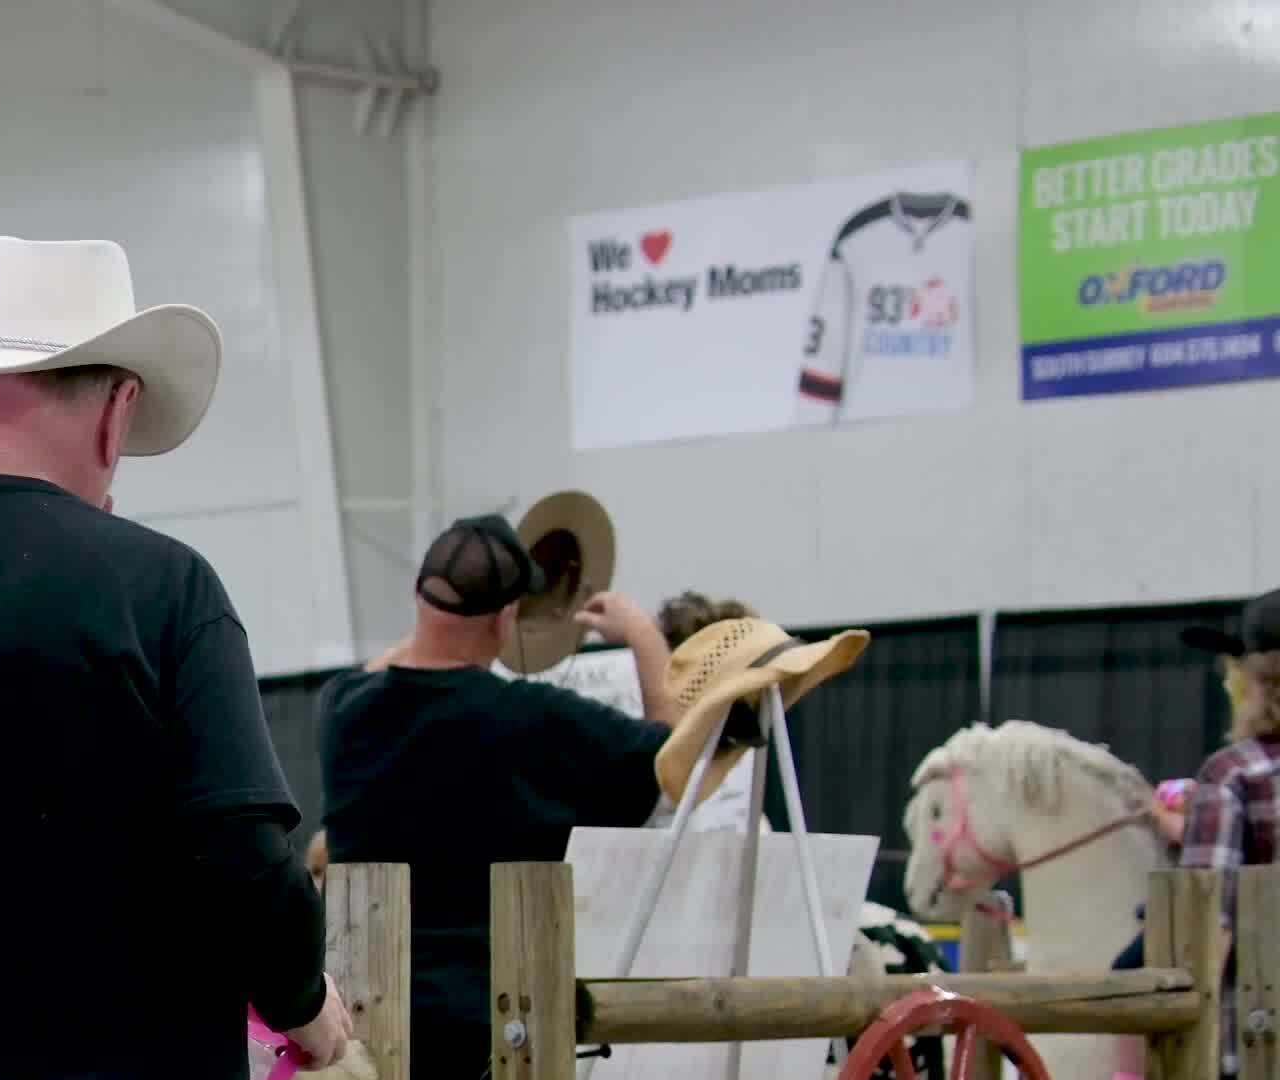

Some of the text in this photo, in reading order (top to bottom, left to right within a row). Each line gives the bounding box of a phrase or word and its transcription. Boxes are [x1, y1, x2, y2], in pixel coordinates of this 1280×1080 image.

[1032, 137, 1280, 208] BETTER GRADES
[1052, 187, 1259, 252] START TODAY
[589, 240, 631, 272] We
[590, 263, 801, 314] Hockey Moms
